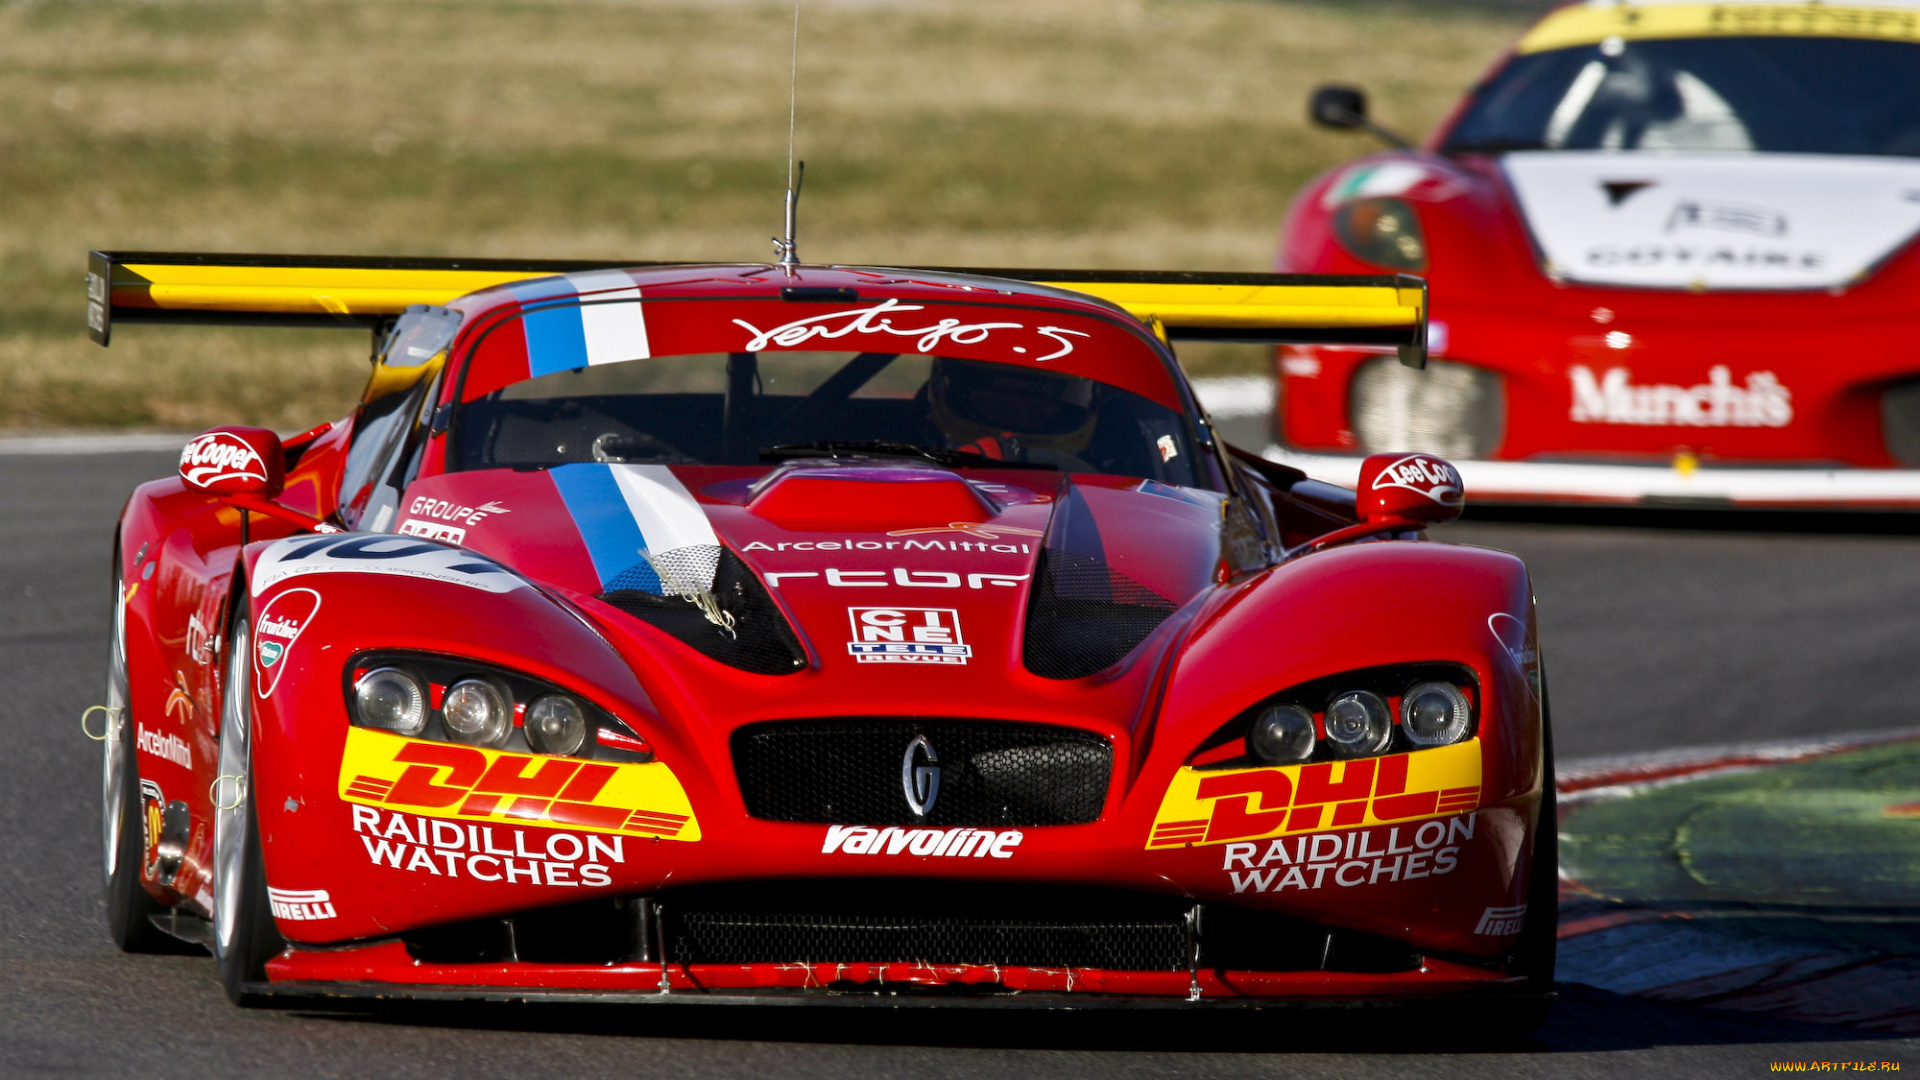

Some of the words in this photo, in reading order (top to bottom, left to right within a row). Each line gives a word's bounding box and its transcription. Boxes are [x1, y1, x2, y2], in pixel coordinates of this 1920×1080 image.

[1570, 364, 1793, 428] Munchi's
[410, 496, 488, 526] GROUPE
[742, 539, 1030, 554] ArcelorMittal
[853, 643, 967, 655] TELE
[864, 654, 961, 663] REVUE
[384, 741, 634, 830] DHL
[902, 734, 941, 816] G
[1196, 753, 1440, 842] DHL
[352, 803, 625, 863] RAIDILLON
[821, 825, 1024, 859] Valvoline
[1222, 812, 1477, 870] RAIDILLON
[360, 834, 613, 887] WATCHES
[1229, 846, 1461, 894] WATCHES
[267, 886, 337, 920] PIRELLI
